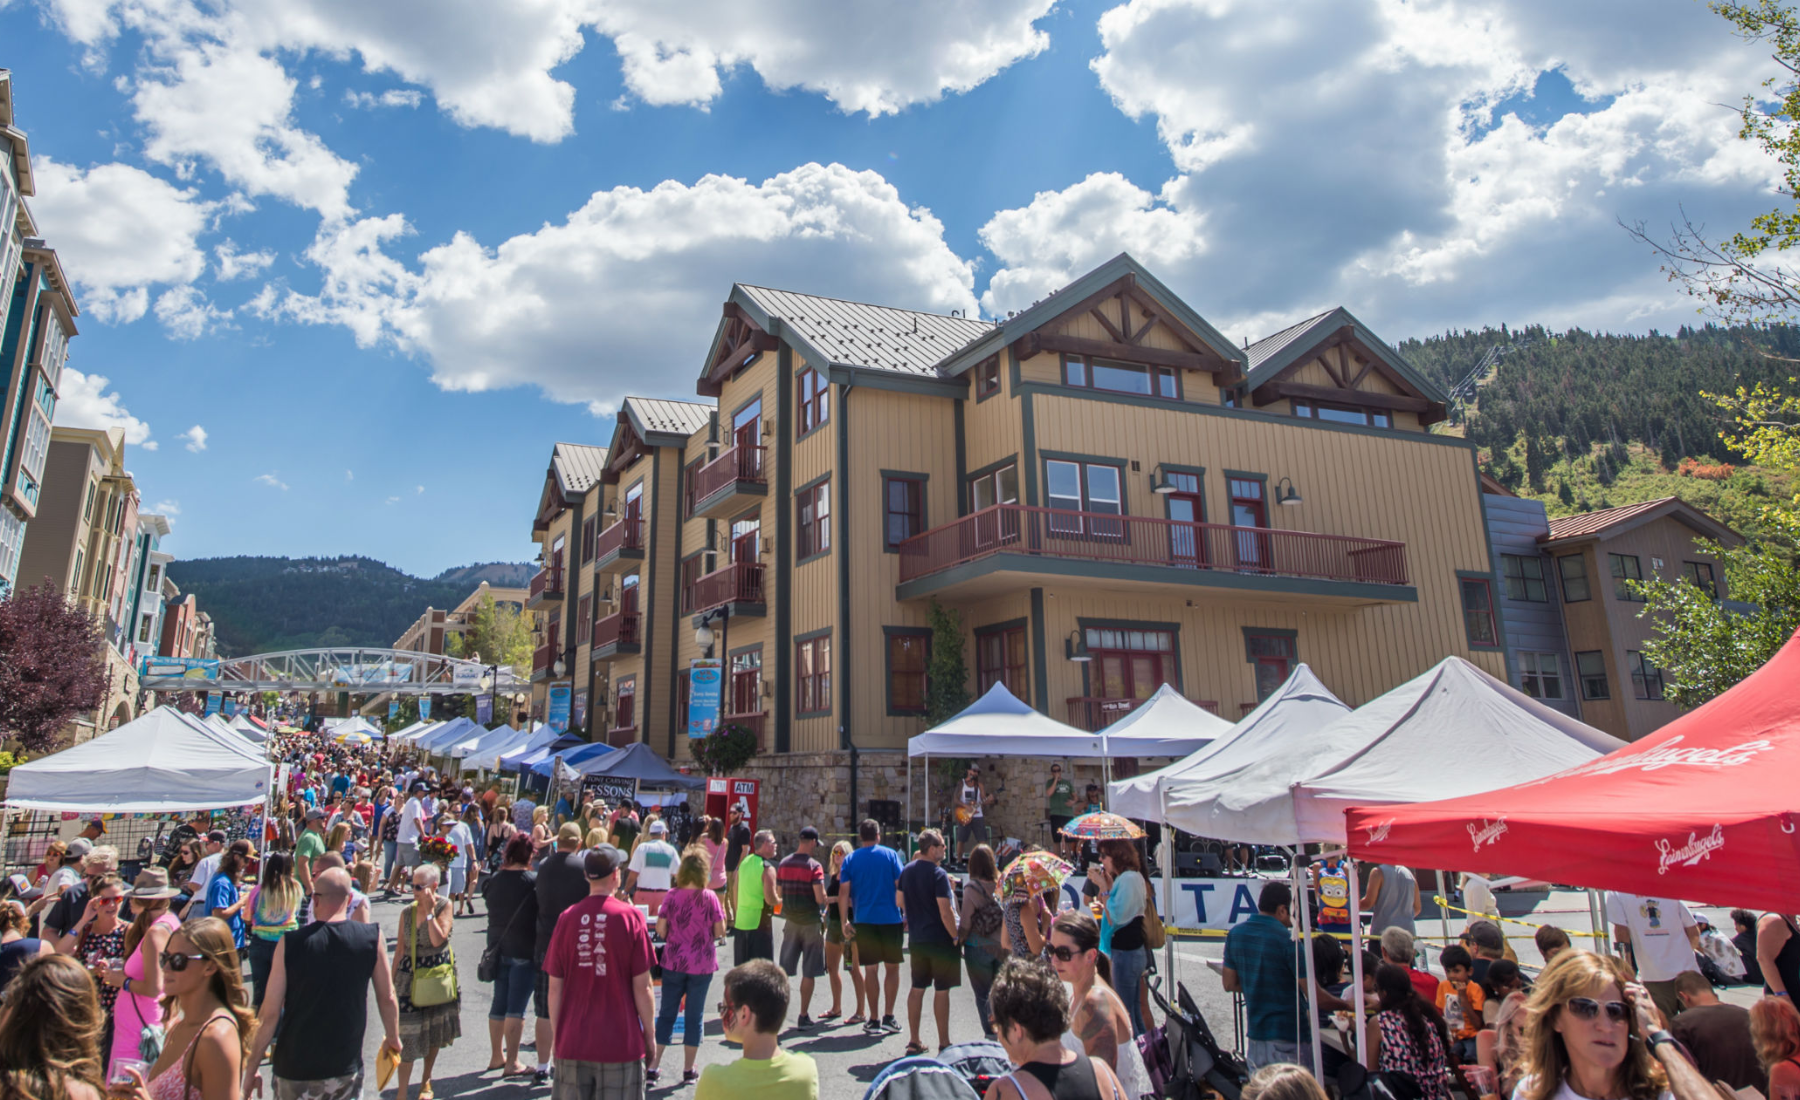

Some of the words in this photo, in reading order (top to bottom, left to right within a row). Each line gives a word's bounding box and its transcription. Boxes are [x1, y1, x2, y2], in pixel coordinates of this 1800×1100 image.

[583, 783, 633, 798] LESSONS
[711, 780, 726, 792] ATM
[735, 783, 754, 793] ATM
[1654, 823, 1725, 875] Leinenkugel's
